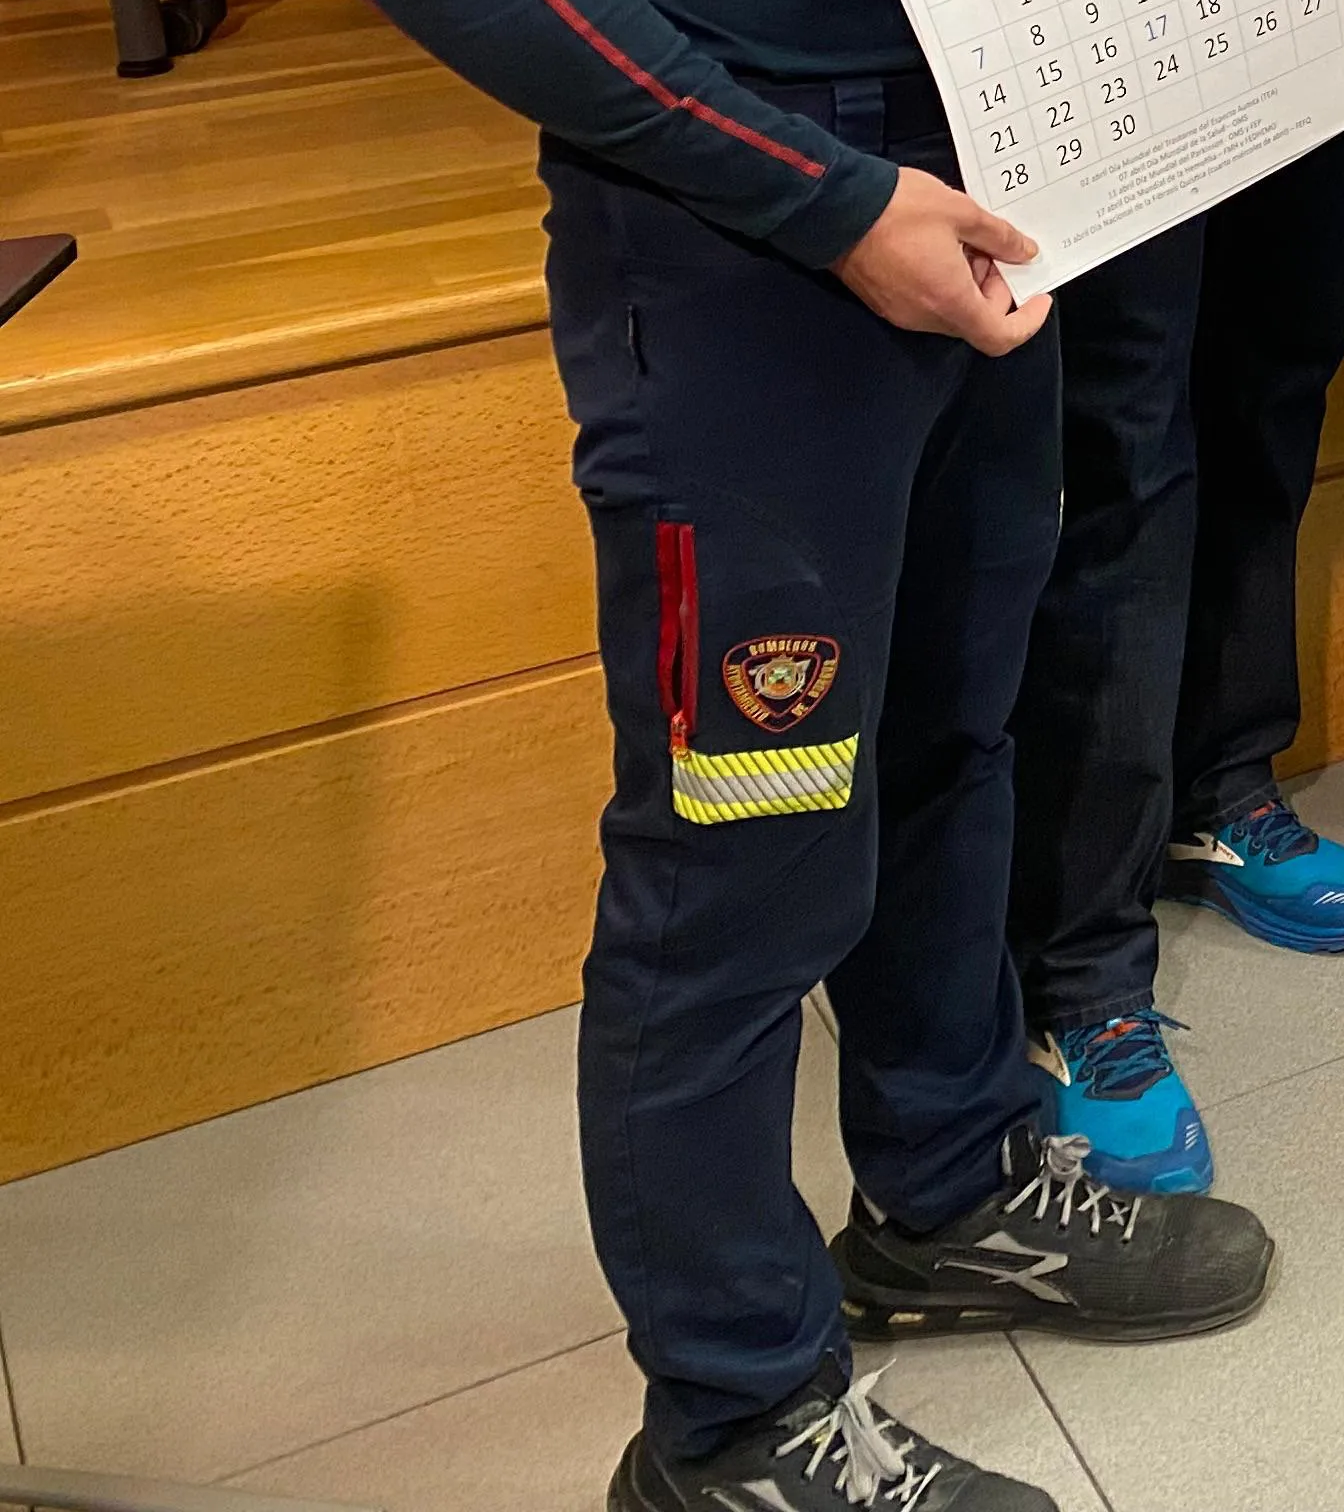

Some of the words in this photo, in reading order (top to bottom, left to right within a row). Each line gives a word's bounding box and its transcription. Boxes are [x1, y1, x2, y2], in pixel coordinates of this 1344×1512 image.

[971, 46, 984, 70] 7
[1030, 24, 1045, 46] 8
[1085, 2, 1099, 24] 9
[979, 83, 1007, 112] 14
[1035, 59, 1063, 88] 15
[1091, 36, 1118, 65] 16
[1144, 14, 1167, 42] 17
[989, 125, 1019, 154] 21
[1046, 100, 1075, 129] 22
[1101, 77, 1127, 104] 23
[1153, 53, 1180, 81] 24
[1204, 32, 1229, 59] 25
[1254, 10, 1277, 37] 26
[1000, 163, 1029, 192] 28
[1056, 138, 1082, 166] 29
[1110, 114, 1136, 142] 30
